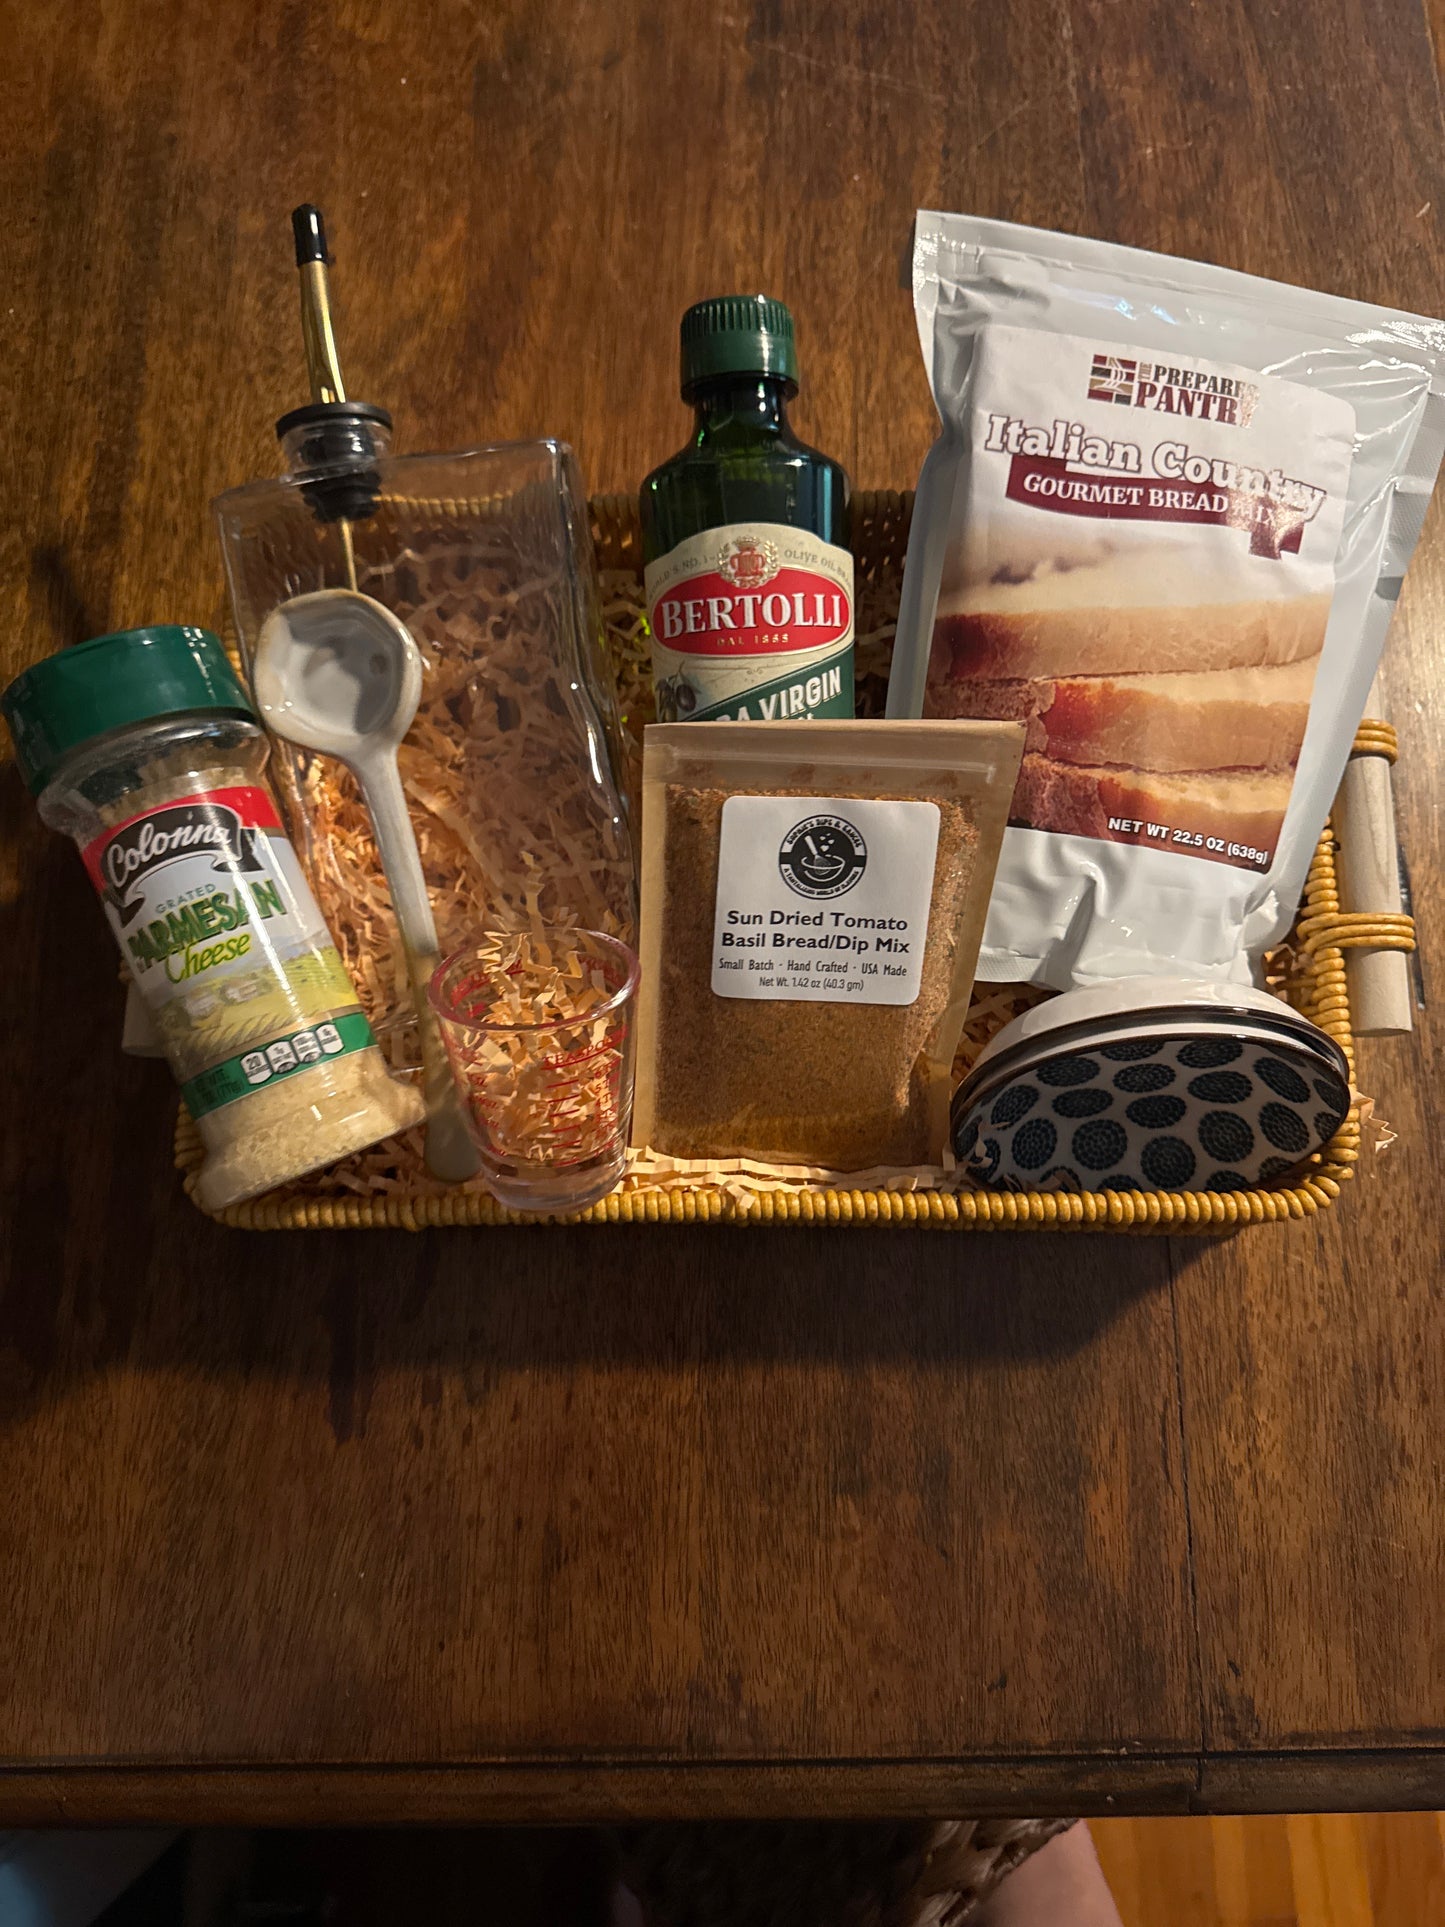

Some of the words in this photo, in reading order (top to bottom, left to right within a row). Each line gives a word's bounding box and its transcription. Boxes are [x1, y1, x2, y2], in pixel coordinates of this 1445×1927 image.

[1152, 364, 1260, 402] PREPARE
[985, 414, 1141, 474] Italian
[1151, 440, 1328, 523] Country
[1023, 472, 1143, 506] GOURMET
[1148, 487, 1229, 514] BREAD
[784, 549, 818, 563] OLIVE
[661, 592, 842, 640] BERTOLLI
[758, 666, 842, 720] VIRGIN
[106, 821, 233, 888] Colonna
[1108, 817, 1143, 834] NET
[1146, 823, 1170, 839] WT
[1172, 829, 1204, 847] 22.5
[1206, 837, 1225, 852] OZ
[1227, 842, 1270, 865] (638g)
[155, 883, 217, 914] GRATED
[727, 910, 763, 925] Sun
[769, 910, 824, 926] Dried
[830, 912, 908, 931] Tomato
[165, 933, 251, 984] Cheese
[722, 932, 766, 948] Basil
[772, 932, 869, 955] Bread/Dip
[875, 938, 910, 954] Mix
[719, 957, 744, 970] Small
[749, 959, 774, 971] Batch
[787, 960, 811, 972] Hand
[816, 960, 848, 973] Crafted
[861, 963, 878, 975] USA
[883, 964, 908, 977] Made
[759, 977, 773, 987] Net
[792, 977, 809, 988] 1.42
[810, 979, 822, 988] oz
[823, 977, 845, 990] (40.3
[846, 978, 864, 992] gm)
